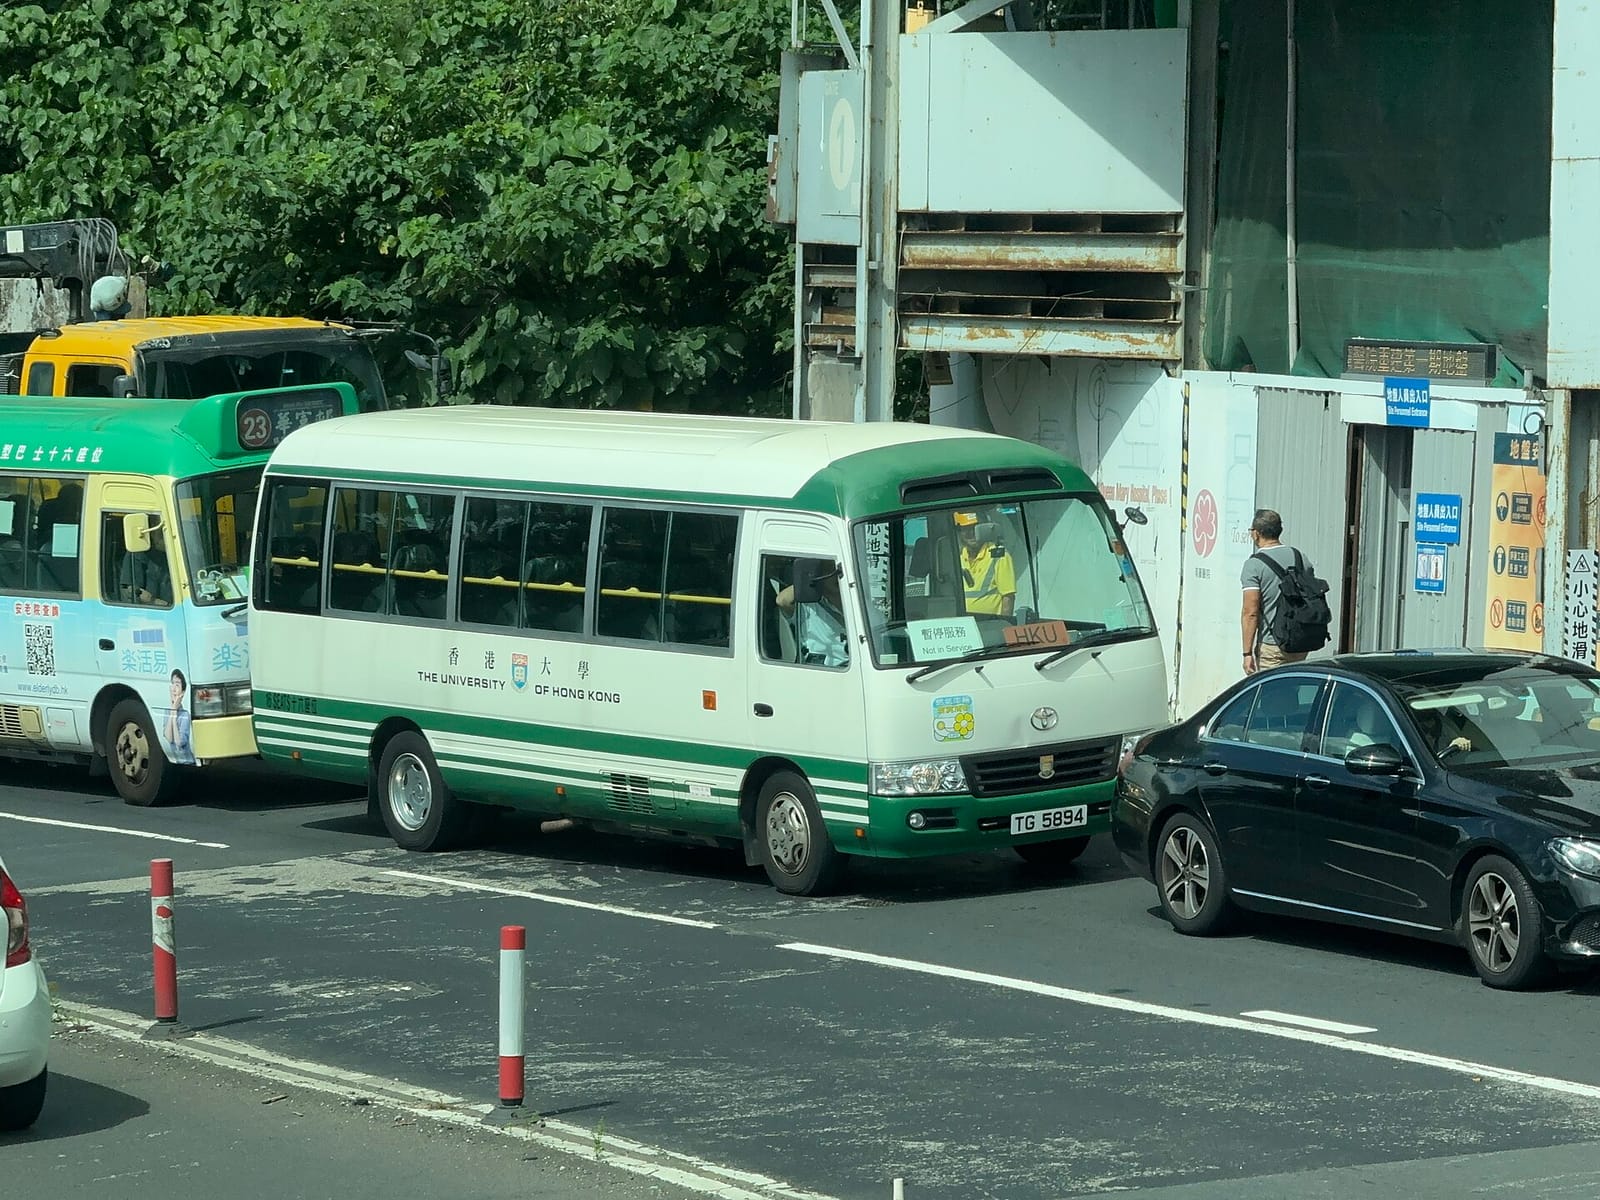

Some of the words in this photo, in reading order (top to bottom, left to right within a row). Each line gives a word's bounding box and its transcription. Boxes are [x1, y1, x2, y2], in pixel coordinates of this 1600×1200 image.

[1386, 387, 1428, 403] 地盤人員出入口
[243, 415, 267, 440] 23
[1417, 504, 1458, 519] 地盤人員出入口
[1572, 580, 1589, 660] 小心地滑
[921, 626, 967, 641] 暫停服務
[1014, 625, 1058, 644] HKU
[213, 643, 249, 671] 楽
[922, 647, 936, 655] Not
[938, 645, 945, 653] in
[946, 644, 973, 653] Service
[417, 671, 438, 683] THE
[441, 674, 506, 690] UNIVERSITY
[535, 684, 550, 696] OF
[553, 687, 585, 699] HONG
[588, 690, 621, 704] KONG
[1015, 815, 1035, 832] TG
[1042, 808, 1084, 828] 5894
